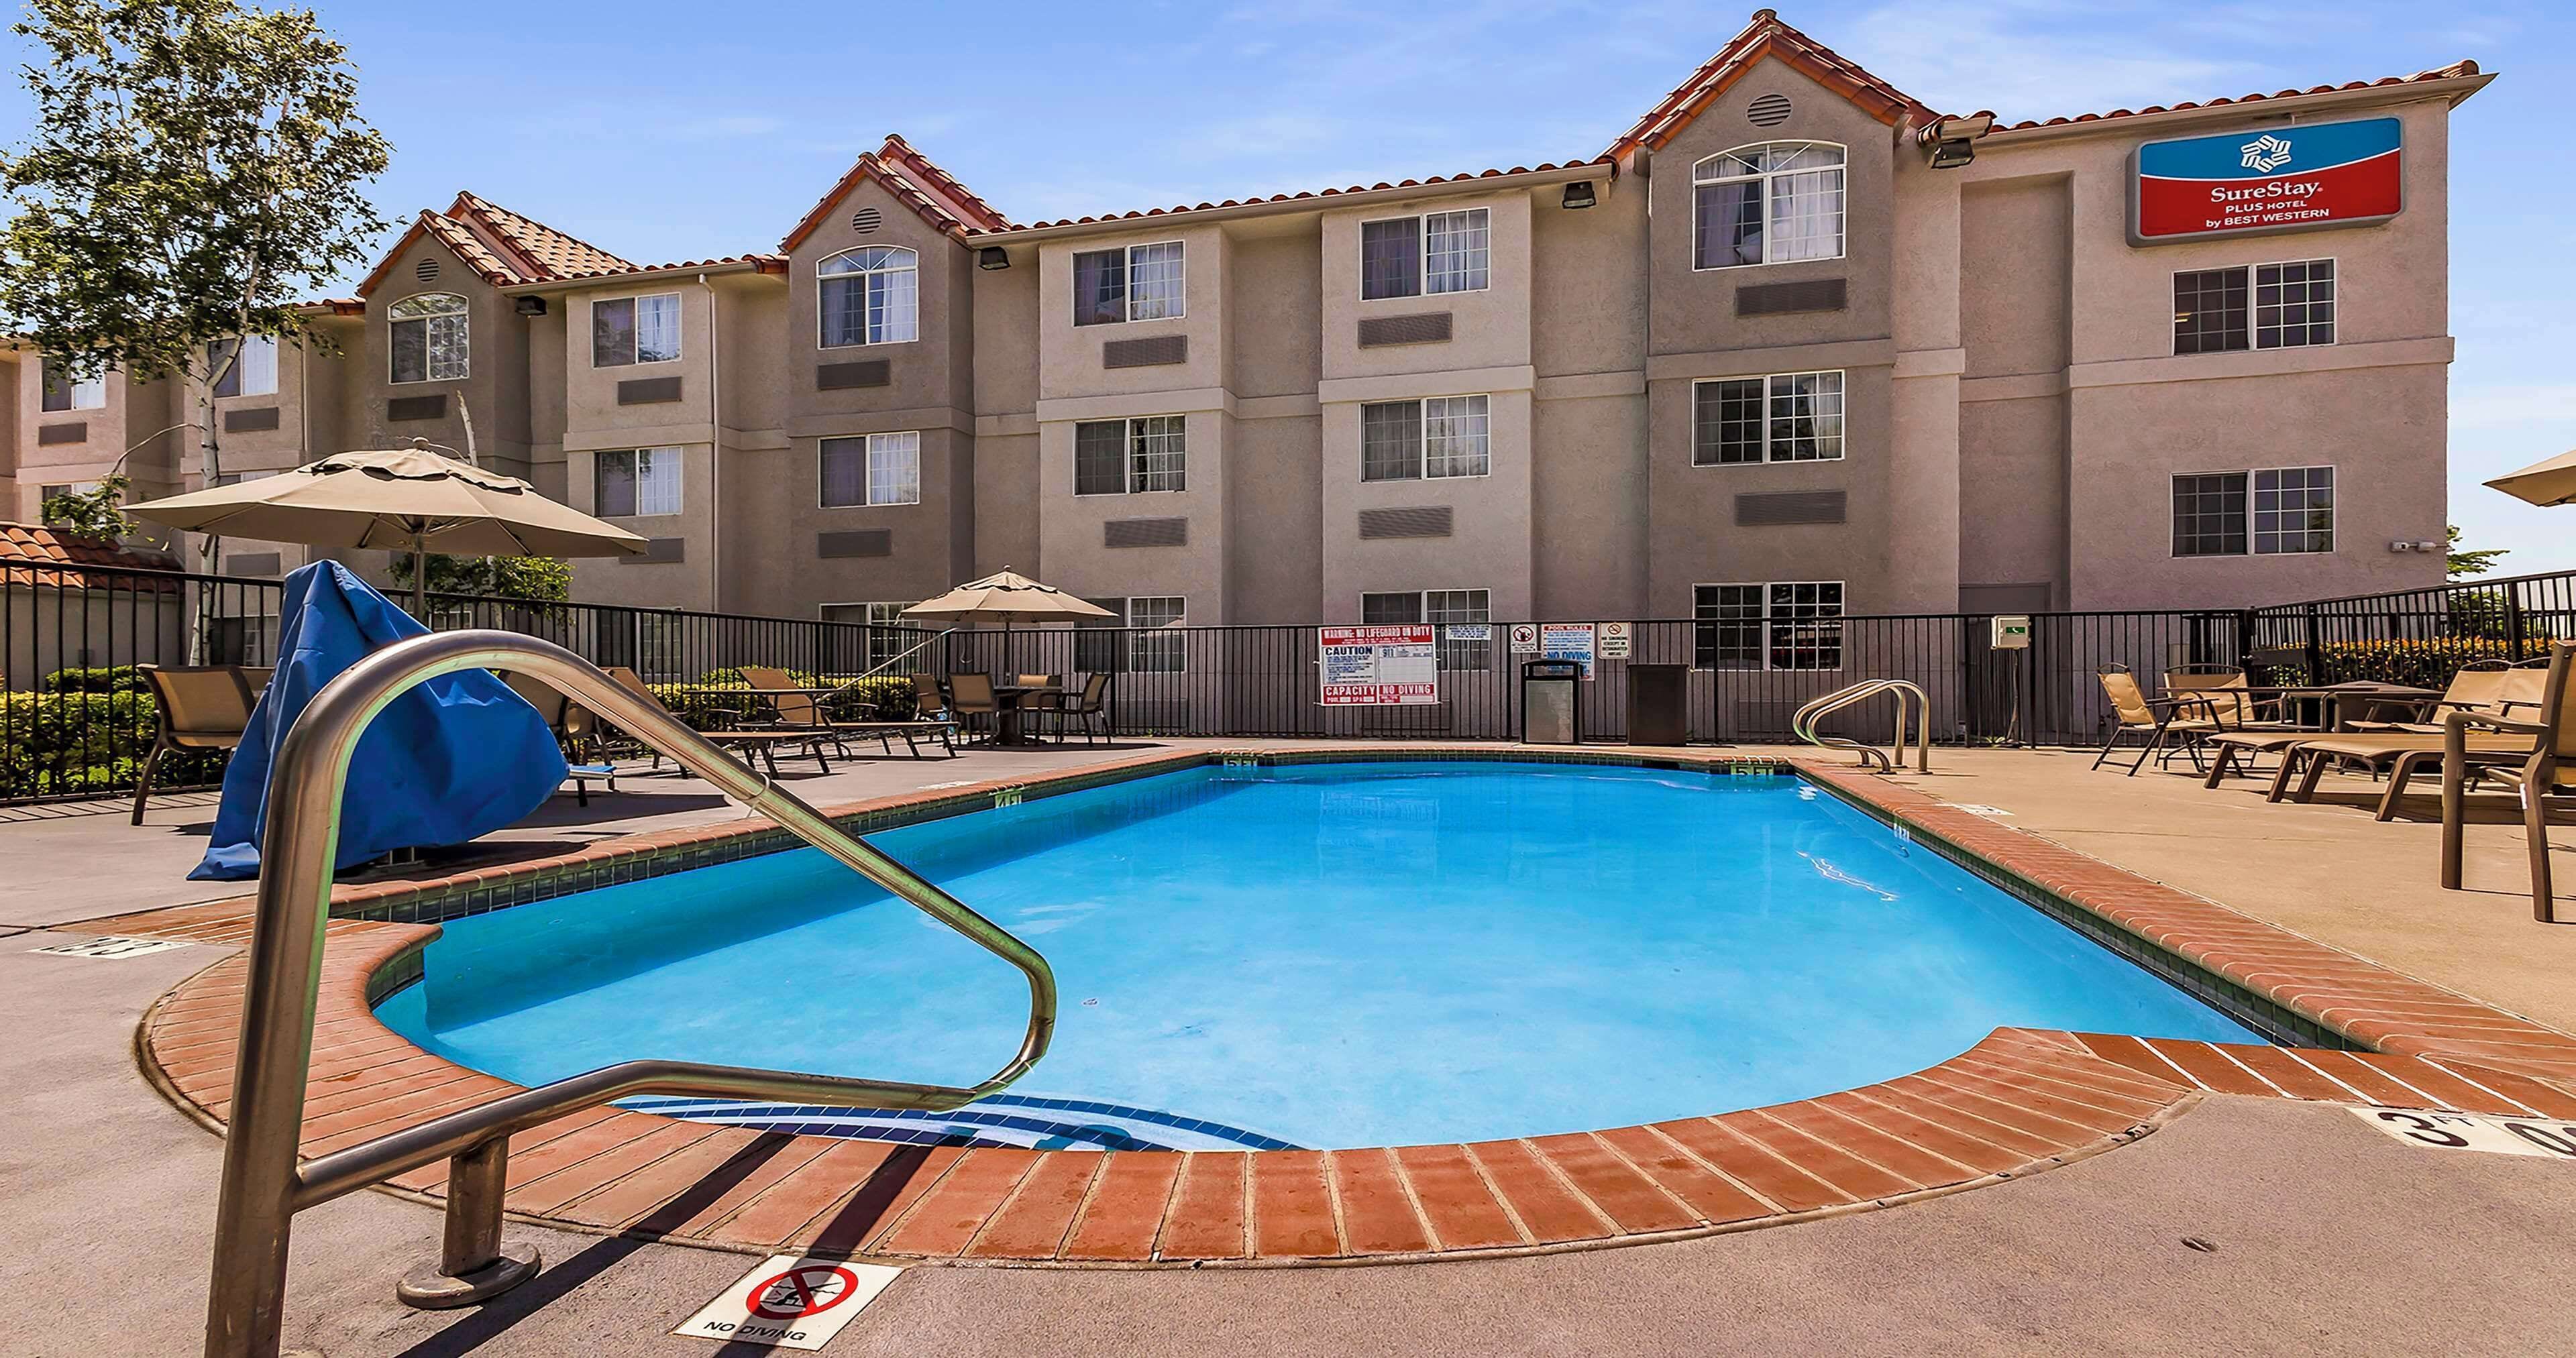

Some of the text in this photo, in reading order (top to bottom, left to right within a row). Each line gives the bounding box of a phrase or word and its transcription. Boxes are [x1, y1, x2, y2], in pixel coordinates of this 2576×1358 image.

[2225, 199, 2307, 214] PLUS HOTEL
[2206, 208, 2329, 229] by BEST WESTERN
[1356, 628, 1365, 638] NO
[1366, 627, 1400, 638] LIFEGUARD
[1402, 627, 1411, 636] ON
[1413, 626, 1430, 636] DUTY
[1325, 646, 1373, 656] CAUTION
[1383, 648, 1394, 658] 911
[1548, 651, 1591, 661] NO DIVING
[1326, 686, 1375, 696] CAPACITY
[1383, 685, 1431, 694] NO DIVING
[2377, 1112, 2475, 1147] 3 FT
[703, 1321, 808, 1341] NO DIVING
